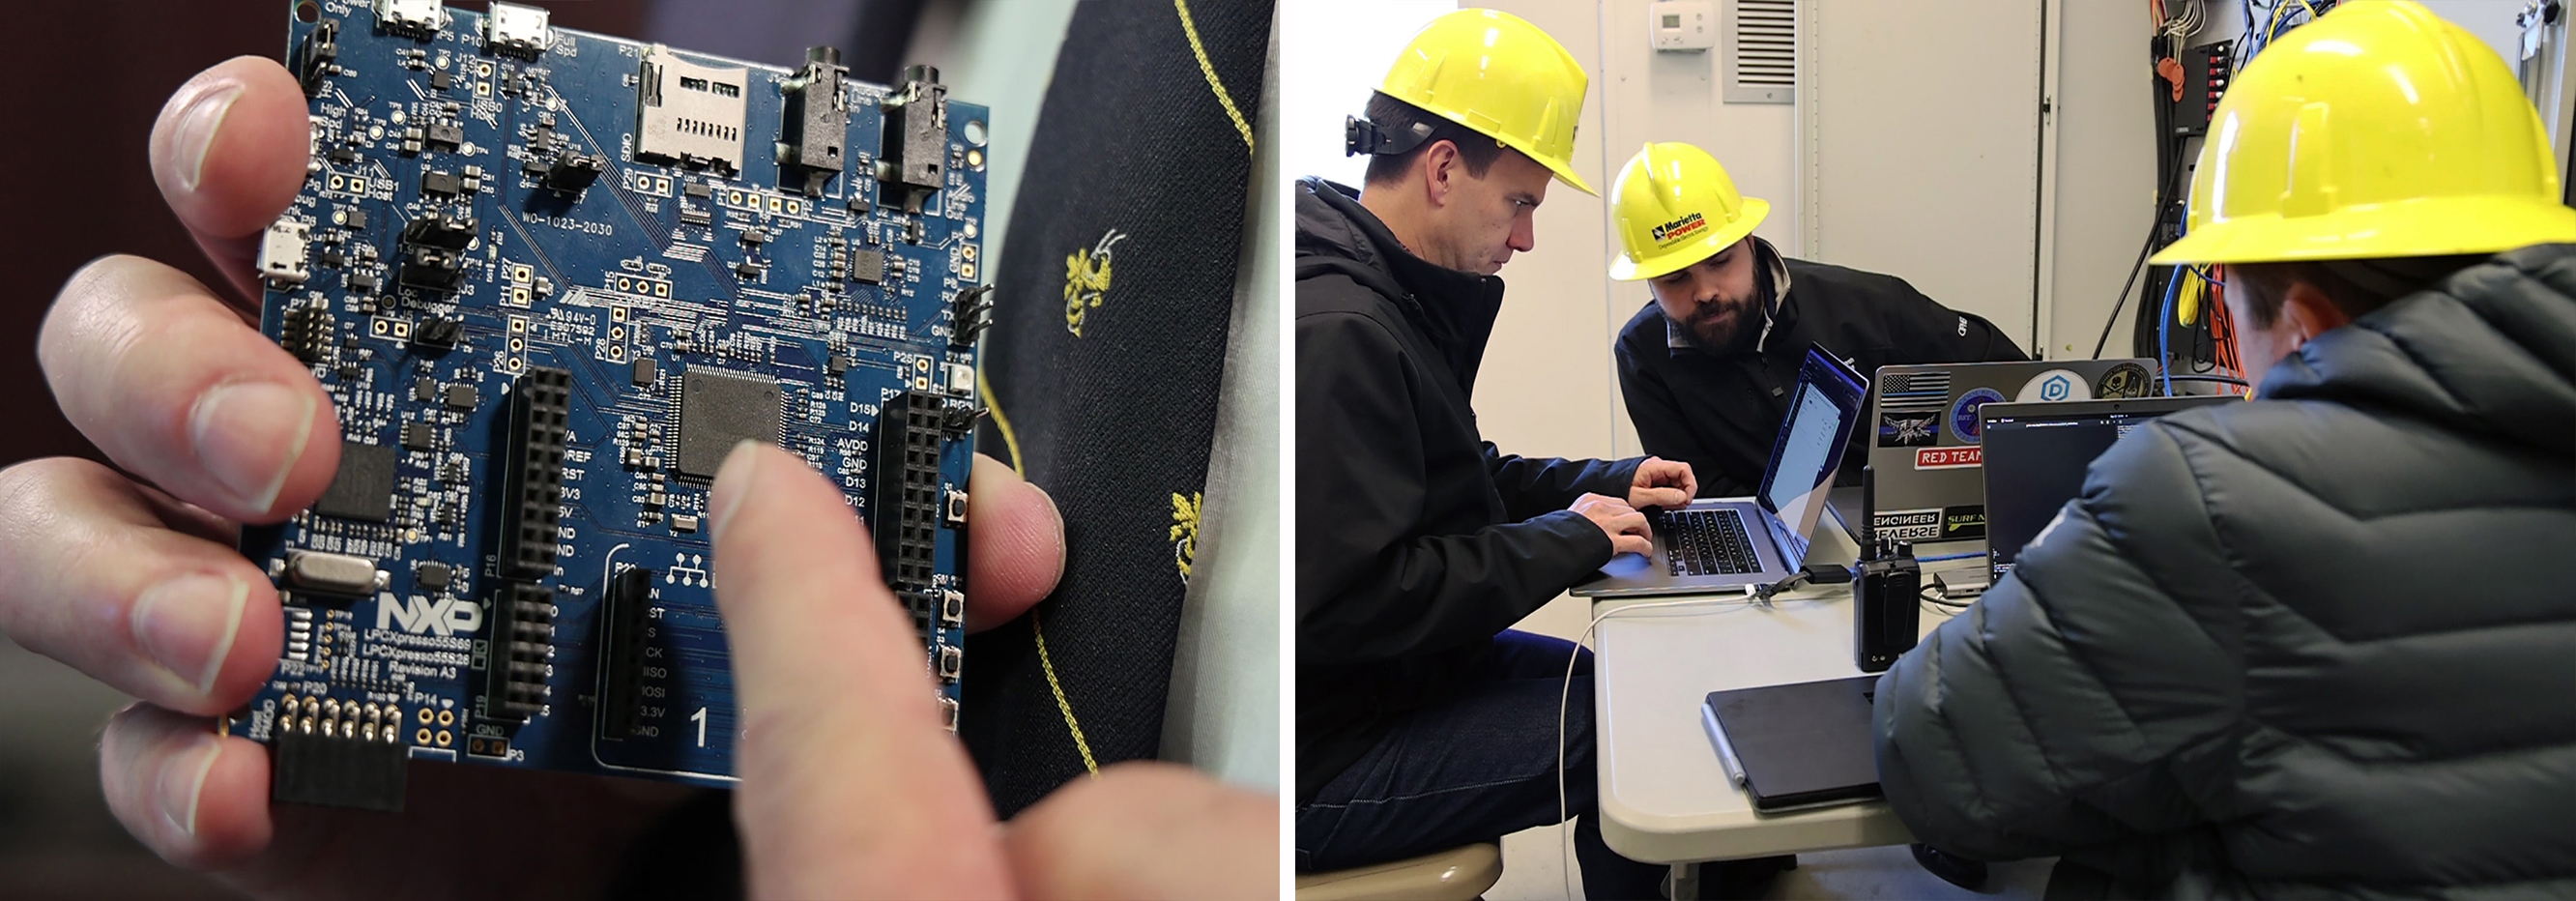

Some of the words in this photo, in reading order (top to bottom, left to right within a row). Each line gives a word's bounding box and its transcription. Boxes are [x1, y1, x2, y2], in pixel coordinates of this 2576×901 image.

[325, 2, 353, 18] Only
[461, 34, 483, 47] P10
[556, 34, 577, 47] Full
[455, 52, 476, 65] J12
[555, 45, 578, 58] Spd
[619, 45, 639, 58] P21
[471, 99, 504, 113] USB0
[851, 93, 873, 106] Line
[320, 102, 347, 117] High
[319, 116, 343, 130] Spd
[621, 132, 633, 162] SDIO
[354, 165, 375, 177] J11
[368, 177, 400, 191] USB1
[622, 167, 634, 190] P29
[367, 188, 393, 201] Host
[300, 216, 317, 227] P6
[944, 208, 964, 221] Out
[522, 211, 613, 237] WO-1023-2030
[1664, 212, 1702, 232] Marietta
[1666, 218, 1706, 240] POWER
[948, 247, 960, 273] GND
[501, 257, 512, 279] P27
[604, 271, 615, 293] P15
[397, 284, 419, 298] Loc
[460, 284, 476, 296] J3
[500, 285, 511, 307] P11
[941, 290, 958, 303] RX
[290, 298, 307, 308] P7
[400, 297, 457, 314] Debugger
[442, 292, 460, 305] Ext
[399, 309, 415, 321] J5
[941, 309, 956, 321] TX
[550, 322, 595, 336] E307592
[931, 324, 956, 338] GND
[594, 337, 607, 361] P28
[492, 350, 505, 373] P26
[893, 351, 913, 364] P25
[850, 401, 871, 415] D15
[849, 420, 870, 433] D14
[836, 437, 869, 451] AVDD
[563, 449, 593, 463] REF
[1922, 451, 1948, 463] RED
[842, 457, 868, 470] GND
[845, 476, 867, 489] D13
[844, 494, 866, 508] D12
[1948, 514, 1977, 523] SURF
[557, 526, 576, 539] ND
[556, 543, 575, 557] ND
[484, 554, 497, 577] P16
[376, 592, 483, 636] NXP
[649, 607, 666, 620] ST
[363, 628, 472, 651] LPCXpresso55S69
[362, 643, 470, 666] LPCXpresso55S28
[645, 647, 663, 658] CK
[388, 660, 438, 678] Revision
[439, 665, 457, 680] A3
[643, 666, 667, 679] ISO
[302, 681, 328, 696] P20
[642, 684, 666, 698] OSI
[414, 691, 438, 706] P14
[475, 694, 486, 718] P19
[640, 705, 666, 717] 3.3V
[260, 698, 276, 741] PMOD
[477, 724, 504, 737] GND
[690, 706, 708, 748] 1
[509, 748, 524, 762] P3
